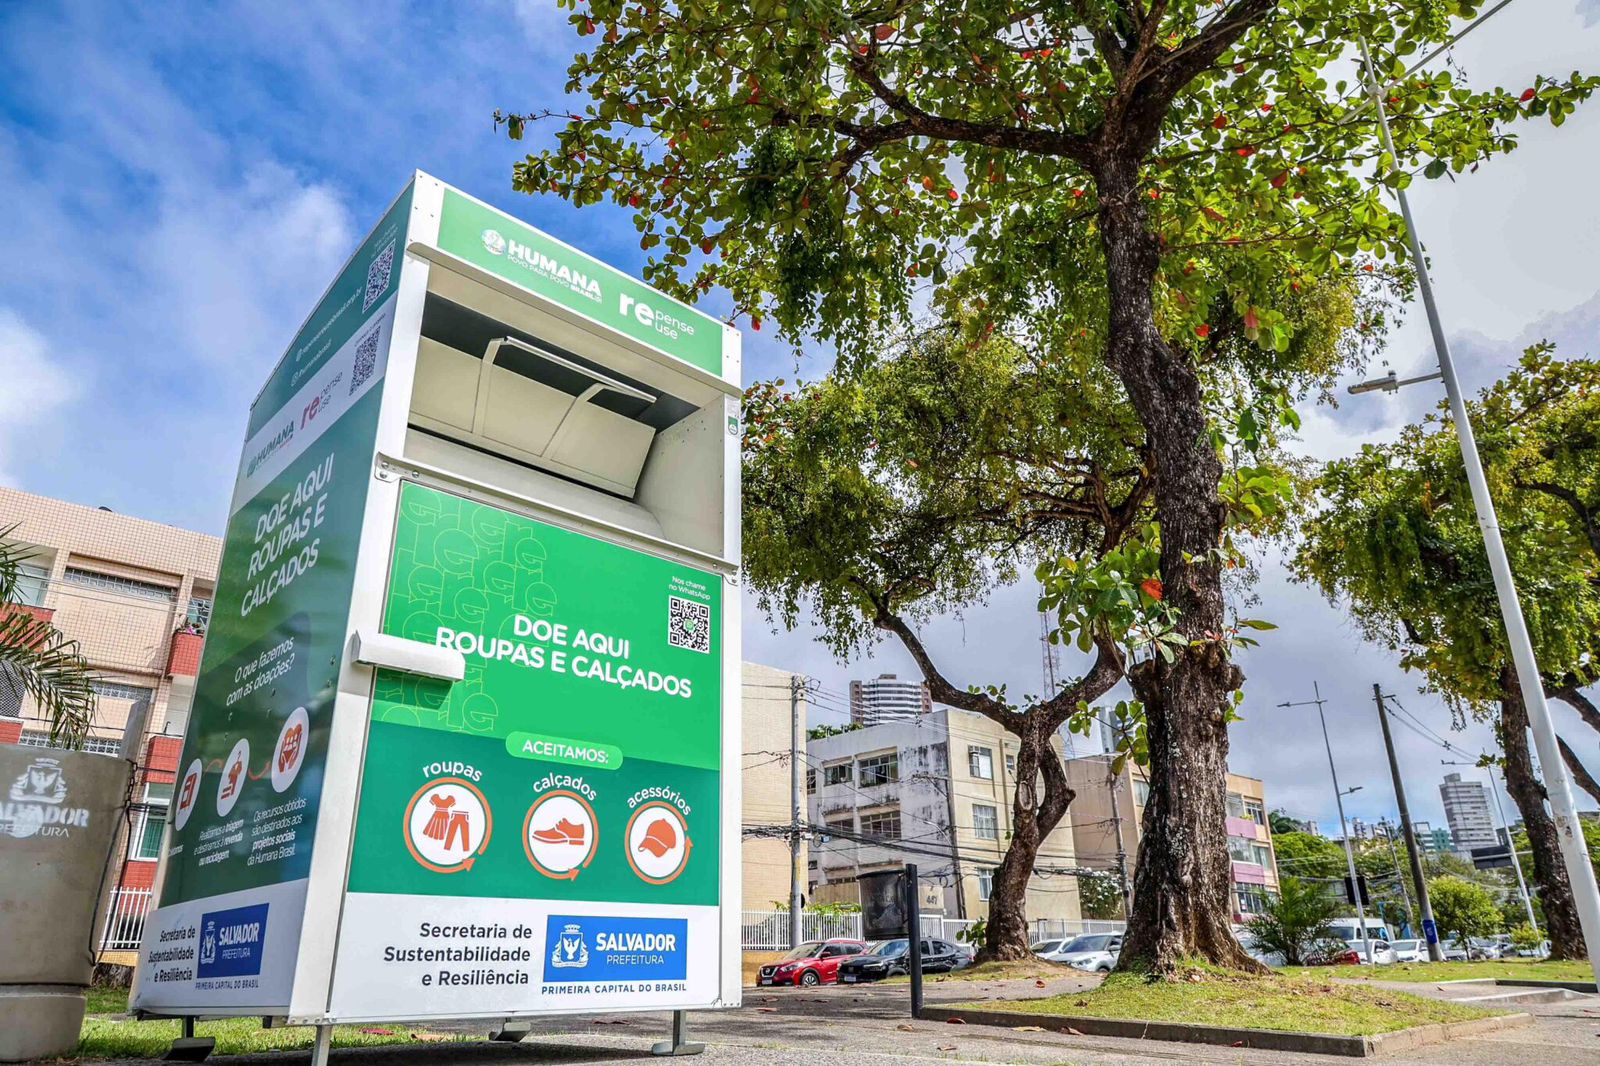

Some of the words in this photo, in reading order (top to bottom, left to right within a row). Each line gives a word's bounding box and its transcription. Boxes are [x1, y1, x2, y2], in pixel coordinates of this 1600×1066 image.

[508, 239, 602, 297] HUMANA
[620, 292, 654, 326] re
[656, 310, 694, 336] pense
[655, 321, 678, 340] use
[300, 396, 320, 430] re
[258, 420, 294, 462] HUMANA
[254, 492, 290, 544] DOE
[290, 452, 335, 514] AQUI
[247, 506, 312, 581] ROUPAS
[314, 492, 328, 528] E
[241, 538, 320, 617] CALÇADOS
[672, 576, 684, 585] Nos
[686, 580, 706, 591] chame
[678, 586, 710, 600] WhatsApp
[514, 614, 568, 646] DOE
[572, 628, 630, 660] AQUI
[234, 666, 242, 683] O
[242, 660, 258, 680] que
[258, 636, 294, 669] fazemos
[436, 626, 544, 668] ROUPAS
[551, 652, 566, 673] E
[572, 656, 692, 699] CALÇADOS
[226, 686, 244, 706] com
[244, 680, 254, 696] as
[254, 652, 295, 690] doações?
[522, 740, 609, 764] ACEITAMOS:
[422, 761, 482, 782] roupas
[532, 772, 597, 801] calçados
[626, 786, 692, 816] acessórios
[291, 814, 303, 826] aos
[255, 850, 278, 864] Humana
[160, 927, 187, 942] Secretaria
[187, 925, 196, 939] de
[219, 922, 260, 946] SALVADOR
[420, 922, 508, 939] Secretaria
[512, 924, 532, 939] de
[595, 932, 676, 952] SALVADOR
[148, 946, 194, 963] Sustentabilidade
[222, 947, 250, 959] PREFEITURA
[384, 946, 531, 962] Sustentabilidade
[606, 954, 664, 965] PREFEITURA
[154, 972, 158, 982] e
[159, 967, 192, 982] Resiliência
[421, 974, 432, 986] e
[438, 968, 529, 986] Resiliência
[195, 982, 214, 990] PRIMEIRA
[215, 981, 233, 989] CAPITAL
[242, 980, 259, 988] BRASIL
[541, 985, 590, 995] PRIMEIRA
[595, 984, 636, 994] CAPITAL
[639, 984, 652, 993] DO
[655, 983, 686, 992] BRASIL
